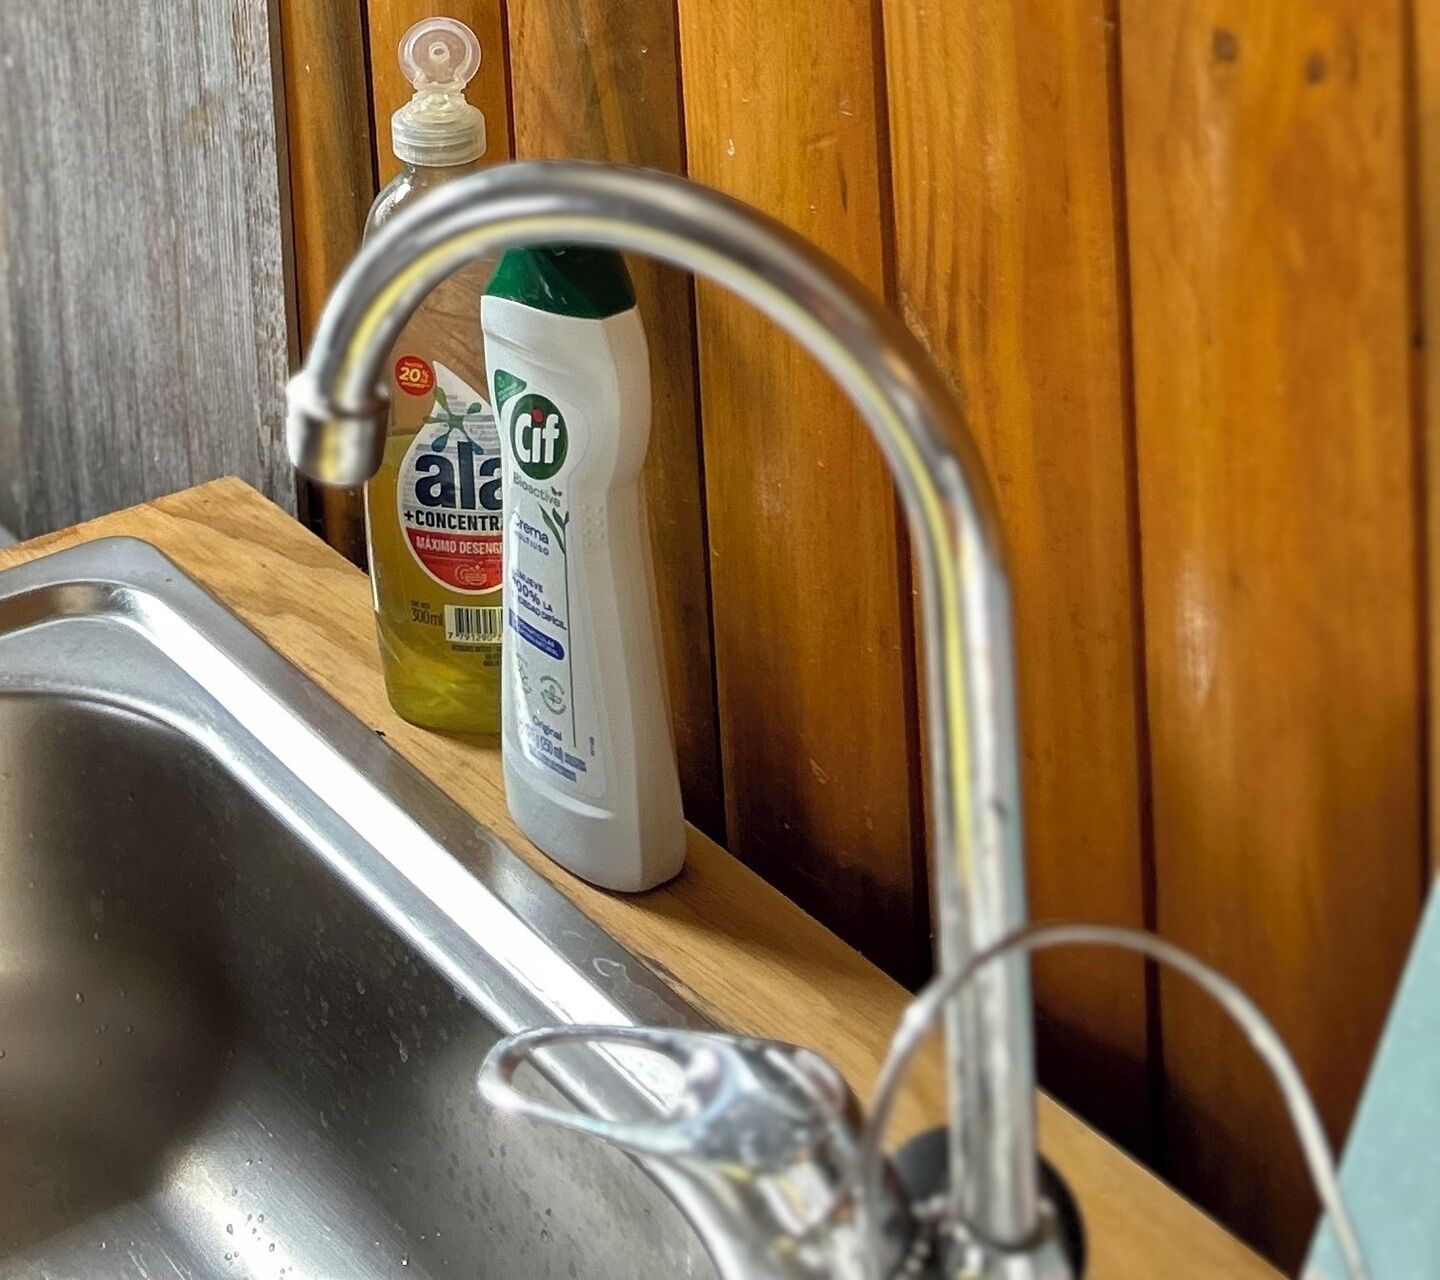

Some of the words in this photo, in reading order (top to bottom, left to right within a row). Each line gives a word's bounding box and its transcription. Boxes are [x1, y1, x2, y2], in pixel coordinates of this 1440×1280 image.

[514, 405, 560, 464] Cif
[414, 441, 502, 510] ala
[513, 471, 561, 508] Bioactive
[404, 510, 502, 532] +CONCENTR
[512, 510, 550, 545] rema
[416, 535, 457, 554] MÁXIMO
